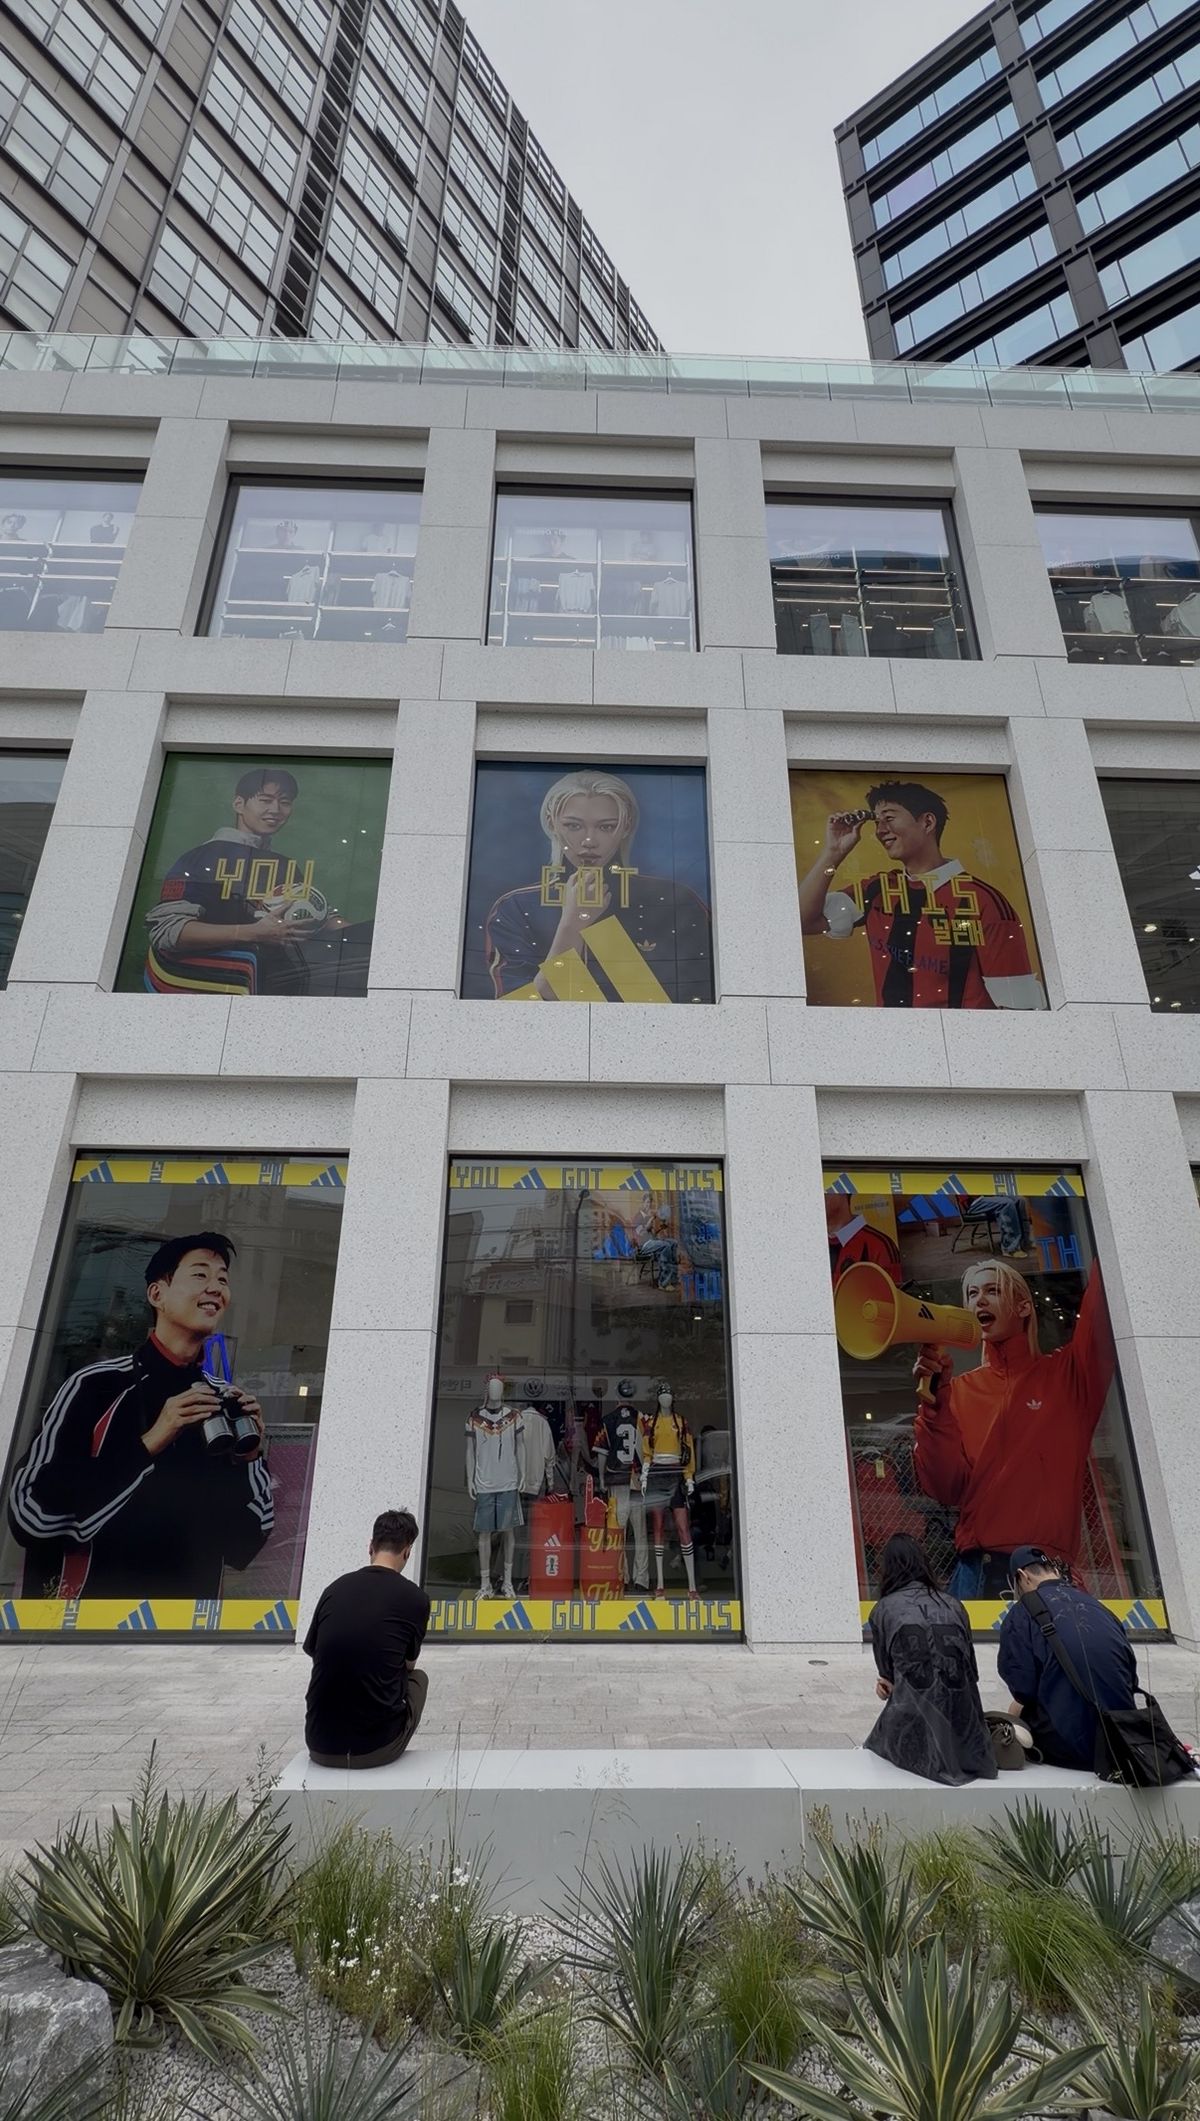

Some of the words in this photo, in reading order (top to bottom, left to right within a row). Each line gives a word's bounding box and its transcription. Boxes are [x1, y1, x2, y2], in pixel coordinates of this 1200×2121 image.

[215, 858, 314, 901] YOU
[540, 865, 638, 908] GOT
[843, 872, 981, 916] THIS
[455, 1166, 499, 1188] YOU
[562, 1167, 604, 1190] GOT
[660, 1168, 716, 1191] THIS
[552, 1600, 601, 1630] GOT
[668, 1600, 733, 1630] THIS
